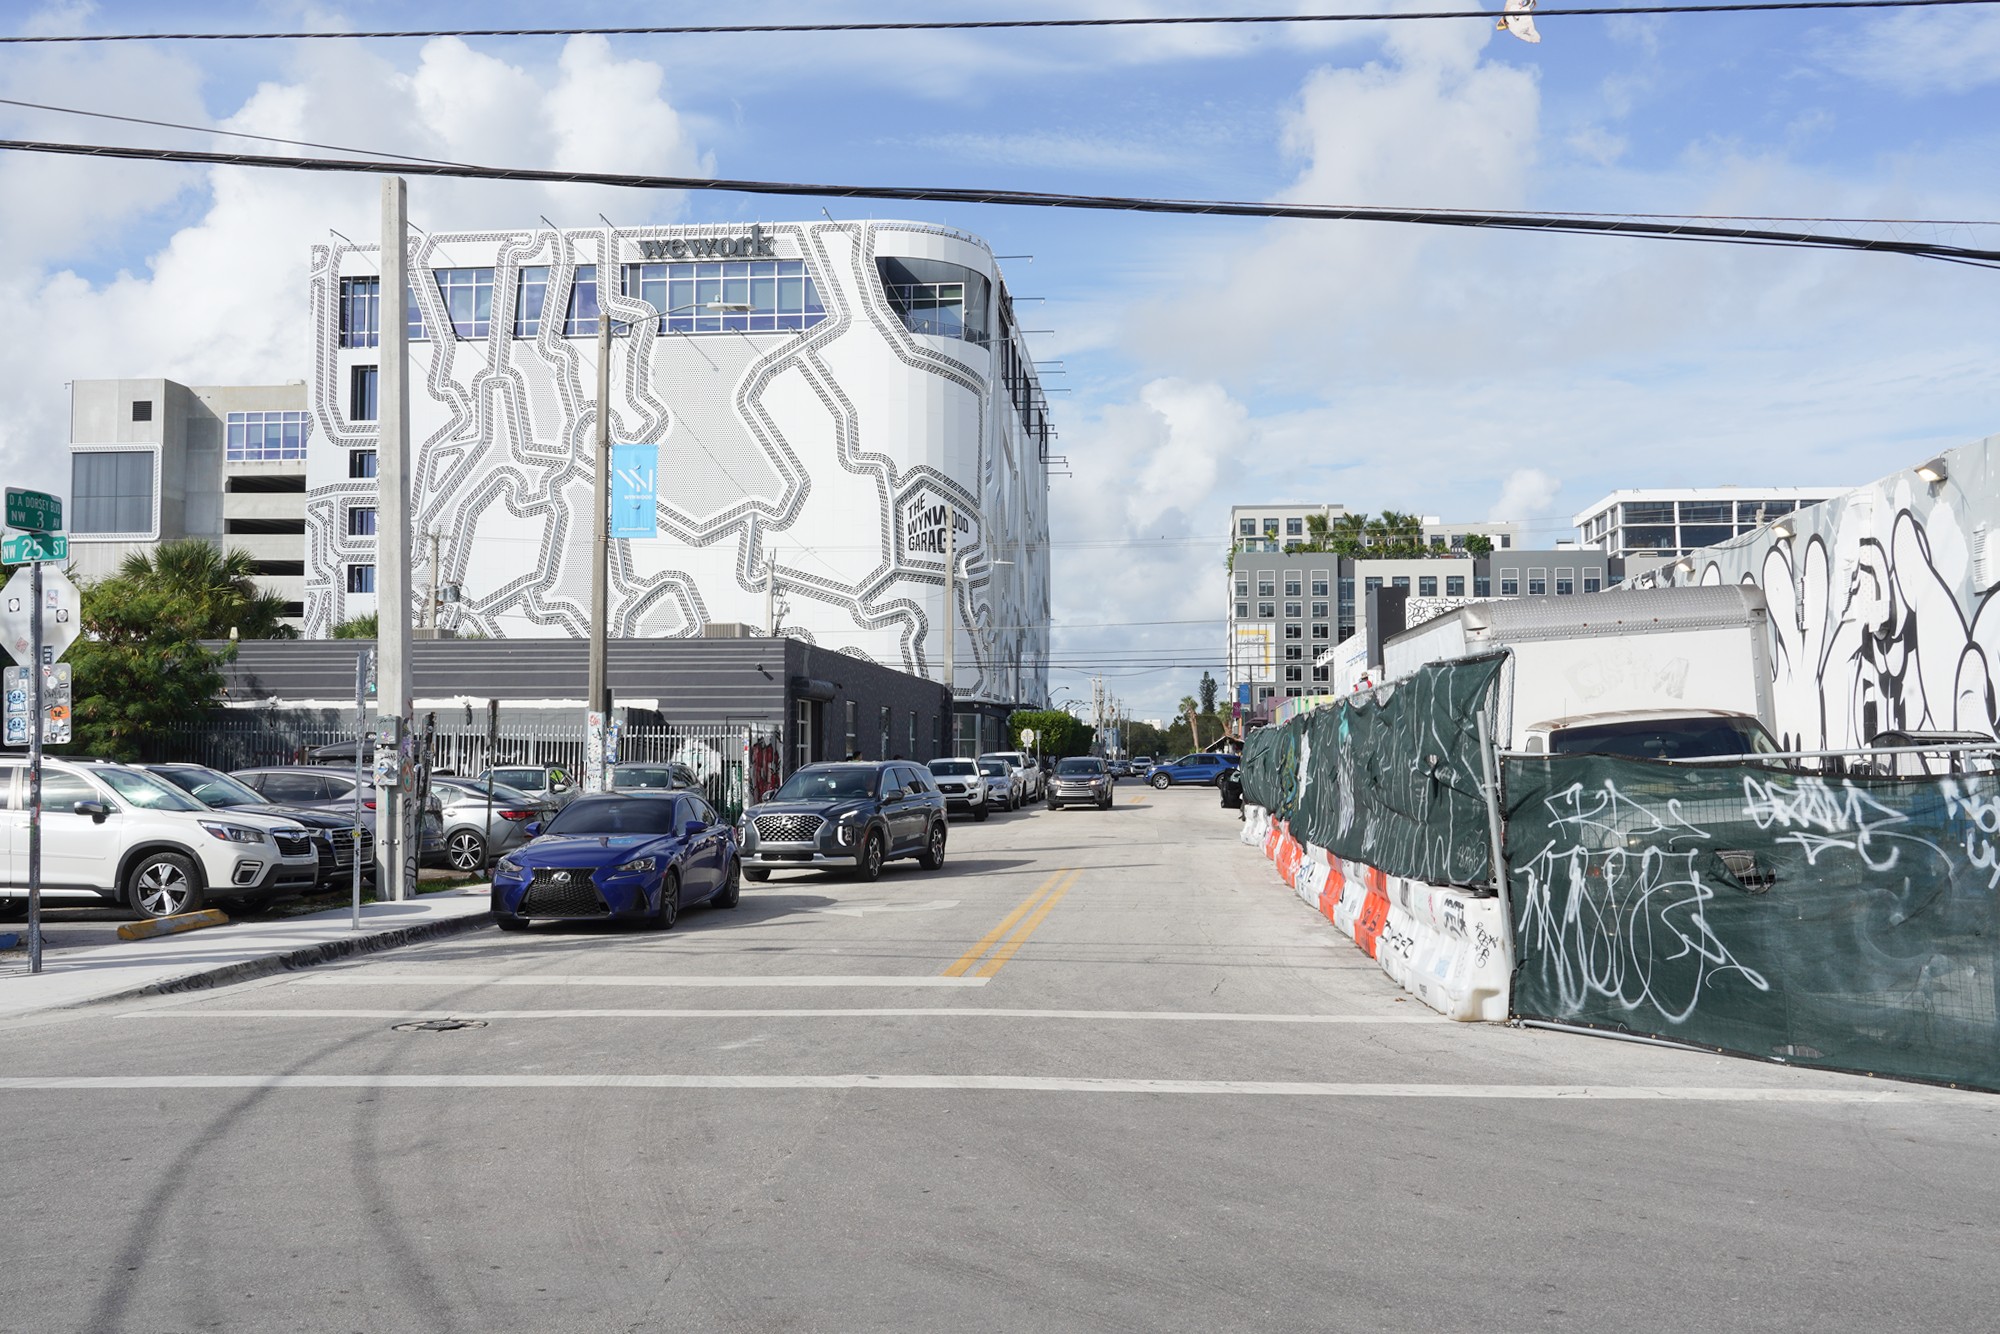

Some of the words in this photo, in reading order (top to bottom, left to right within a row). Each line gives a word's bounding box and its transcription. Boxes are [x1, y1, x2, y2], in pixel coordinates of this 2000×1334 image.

[637, 223, 775, 259] wework
[10, 495, 15, 505] D
[17, 496, 23, 506] A
[26, 497, 49, 511] DORSEY
[50, 501, 60, 515] BLVD
[908, 493, 926, 519] THE
[11, 510, 26, 522] NW
[37, 511, 44, 529] 3
[3, 545, 16, 560] NW
[22, 539, 43, 561] 25
[53, 540, 65, 556] ST
